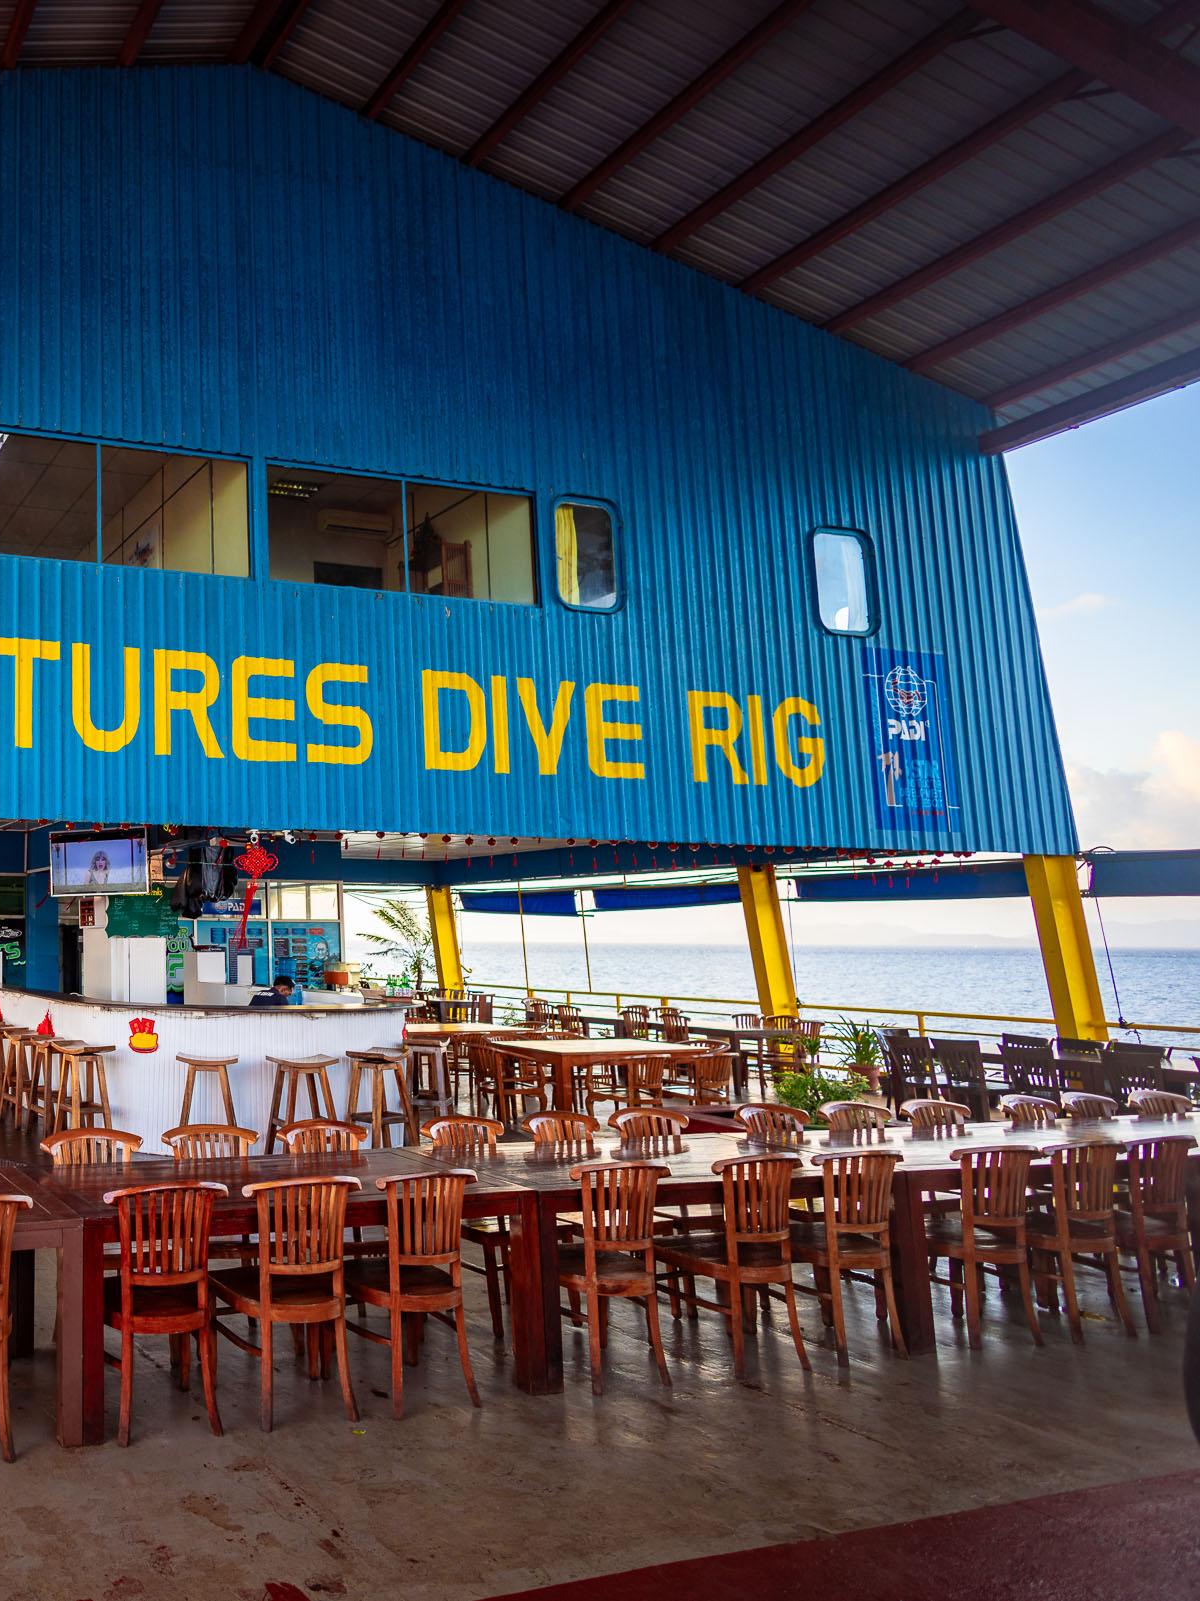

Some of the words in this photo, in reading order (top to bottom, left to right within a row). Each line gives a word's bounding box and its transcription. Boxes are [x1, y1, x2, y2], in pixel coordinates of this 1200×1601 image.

[421, 669, 646, 780] DIVE
[687, 690, 826, 788] RIG
[887, 718, 926, 741] PADI
[228, 902, 246, 912] PAD
